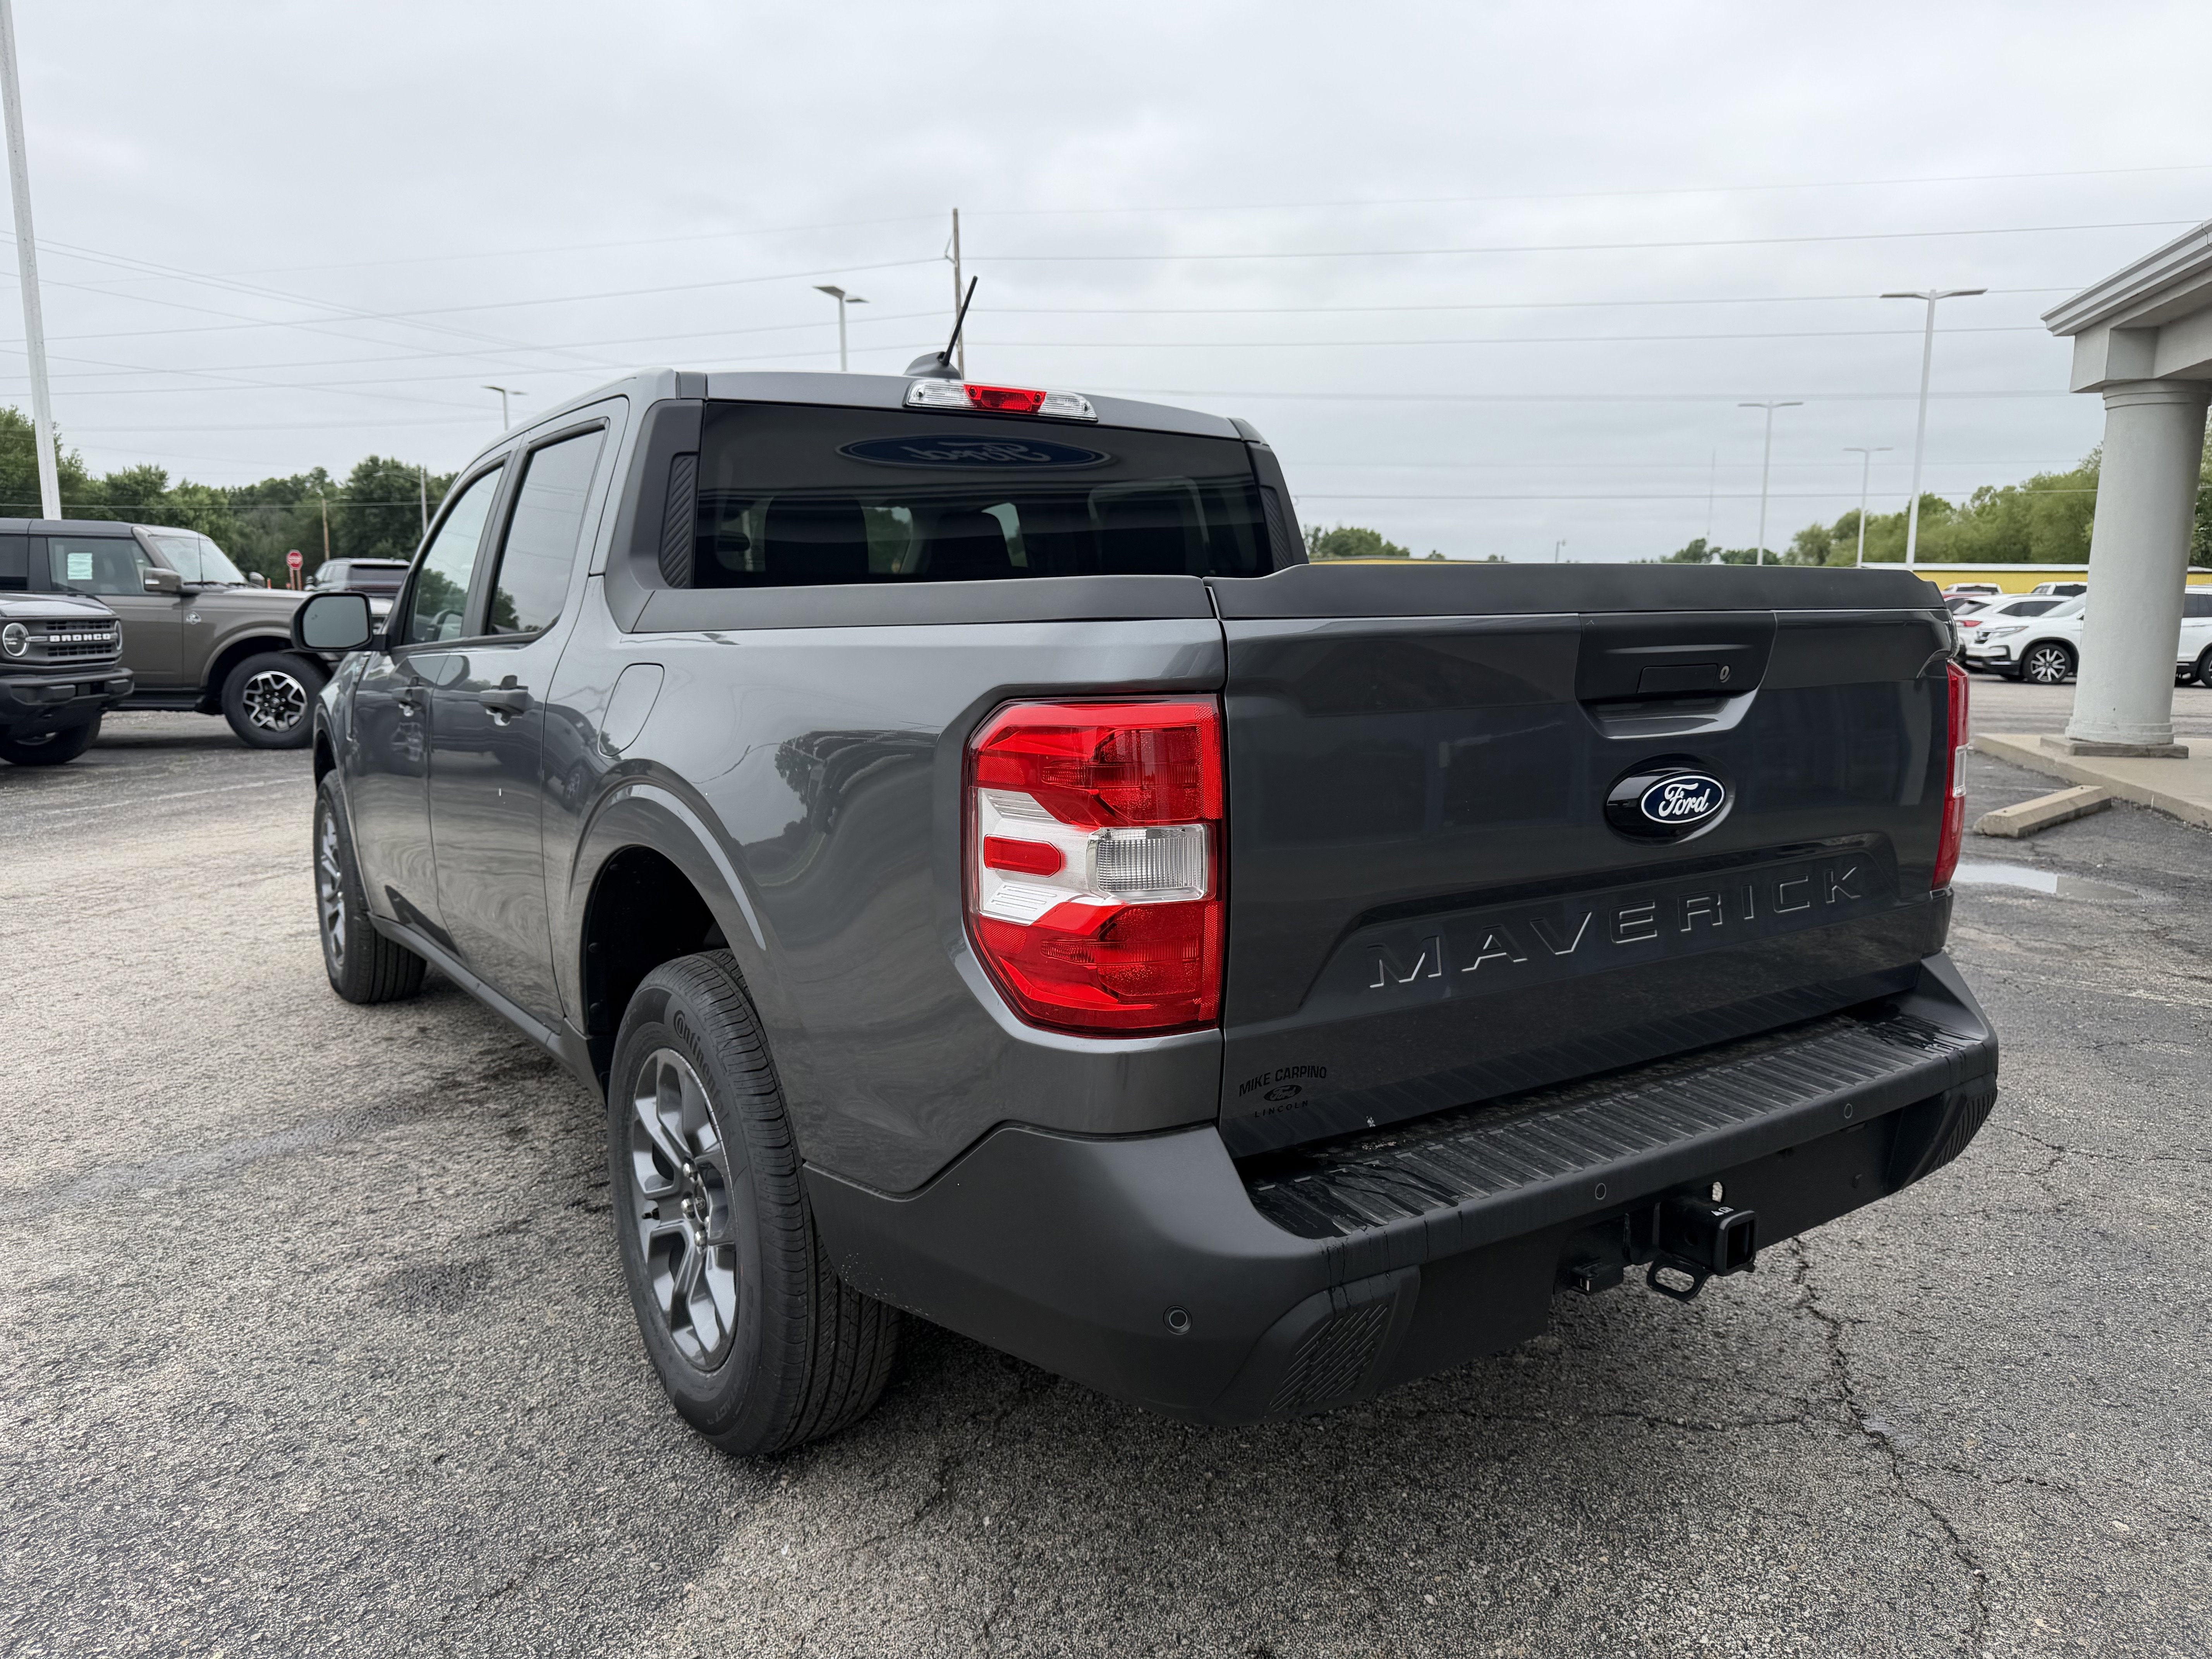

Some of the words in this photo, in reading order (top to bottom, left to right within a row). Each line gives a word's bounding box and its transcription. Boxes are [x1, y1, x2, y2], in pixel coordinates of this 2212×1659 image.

[50, 633, 110, 642] BRONCO
[1658, 782, 1711, 817] Ford
[1367, 866, 1862, 988] MAVERICK
[673, 1010, 730, 1123] Continental
[1239, 1072, 1271, 1097] MIKE
[1275, 1065, 1327, 1082] CARPINO
[1255, 1100, 1308, 1117] LINCOLN
